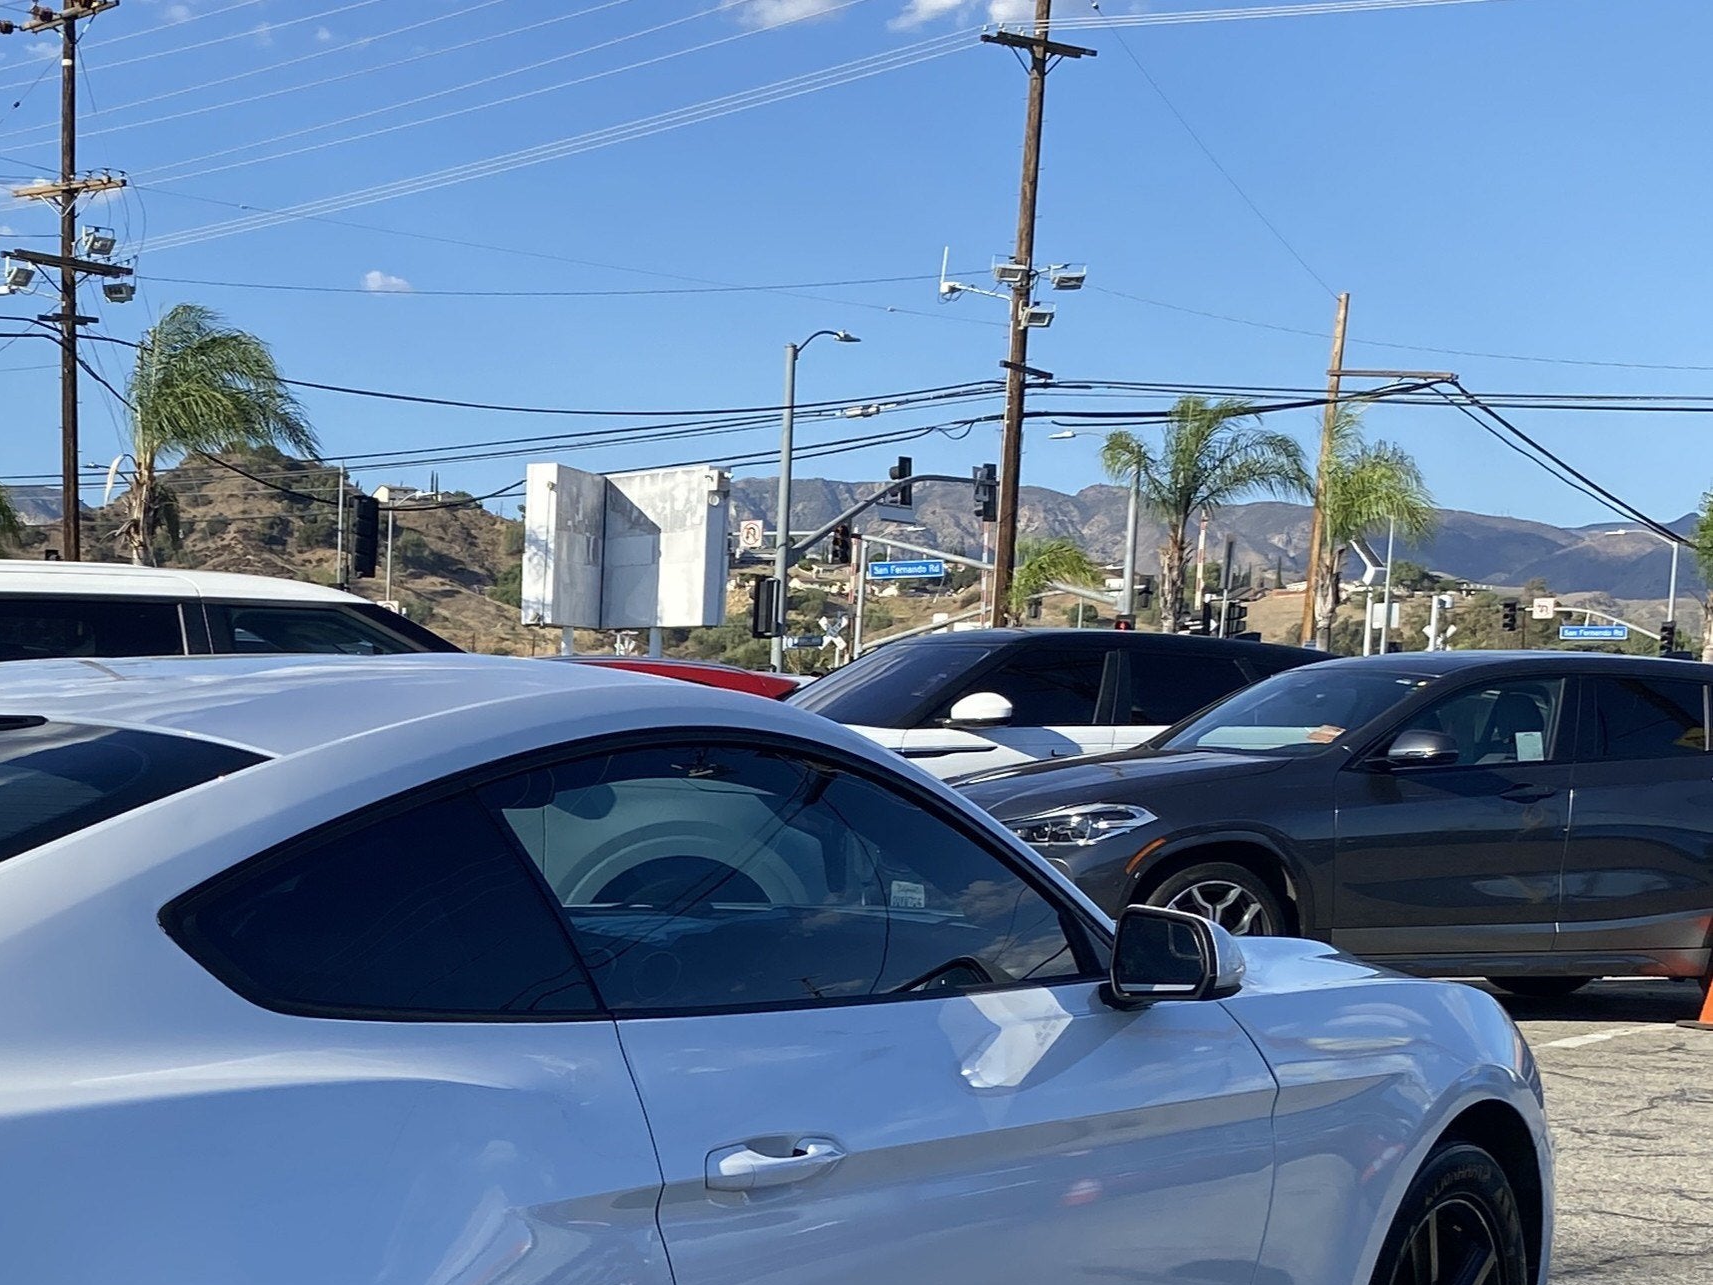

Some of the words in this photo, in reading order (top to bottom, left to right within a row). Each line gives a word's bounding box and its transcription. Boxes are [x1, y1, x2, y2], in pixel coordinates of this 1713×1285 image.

[873, 565, 889, 575] San
[890, 564, 928, 574] Fernando
[929, 564, 940, 573] Rd
[1563, 629, 1577, 637] San
[1579, 629, 1612, 637] Fernando
